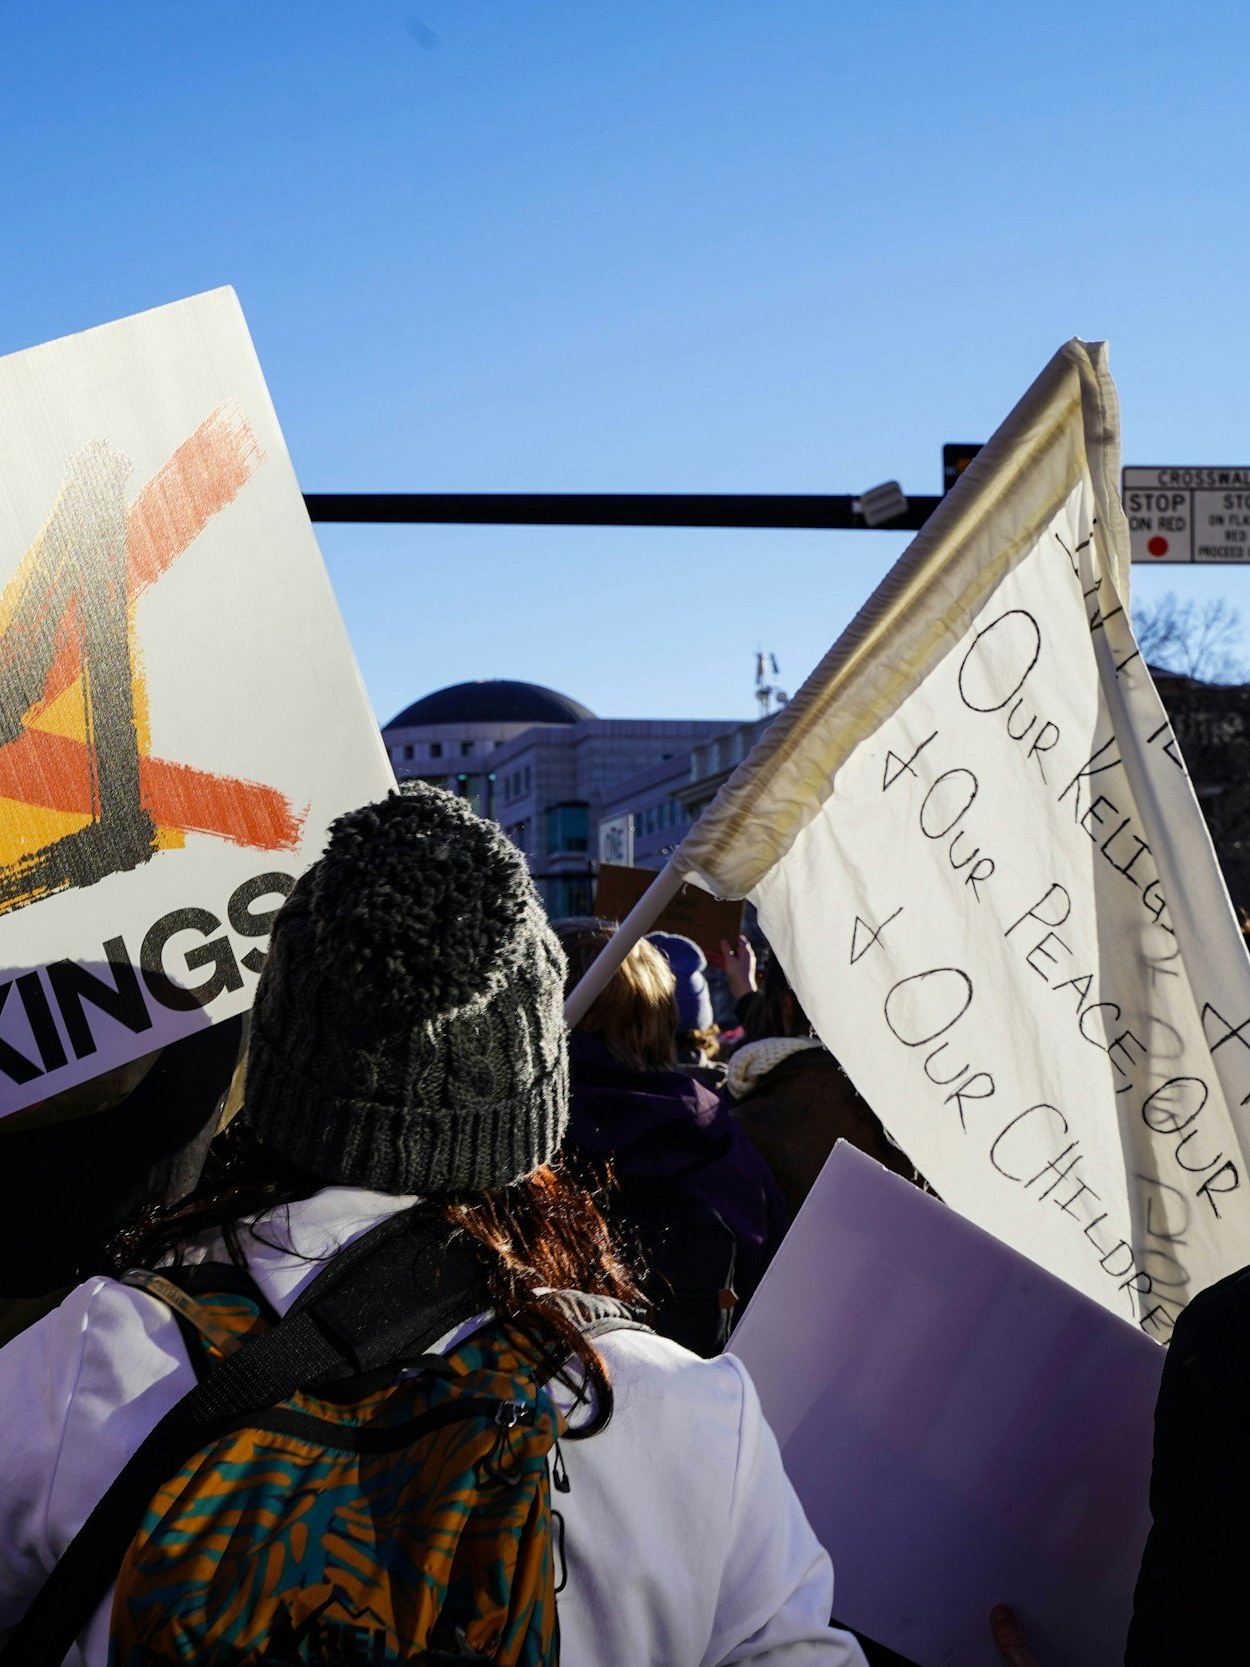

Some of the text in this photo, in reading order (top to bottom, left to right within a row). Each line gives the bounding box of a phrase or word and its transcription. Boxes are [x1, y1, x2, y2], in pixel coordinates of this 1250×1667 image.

[1130, 493, 1185, 512] STOP
[1130, 516, 1185, 532] ON RED
[1209, 515, 1224, 527] ON
[1225, 530, 1247, 542] RED
[1198, 545, 1244, 558] PROCEED
[958, 609, 1060, 786] OUR
[1057, 736, 1176, 936] RELIG
[883, 731, 938, 792] 4
[920, 768, 995, 904] OUR
[1142, 1076, 1240, 1220] OUR
[850, 907, 903, 965] 4
[885, 967, 995, 1135] OUR
